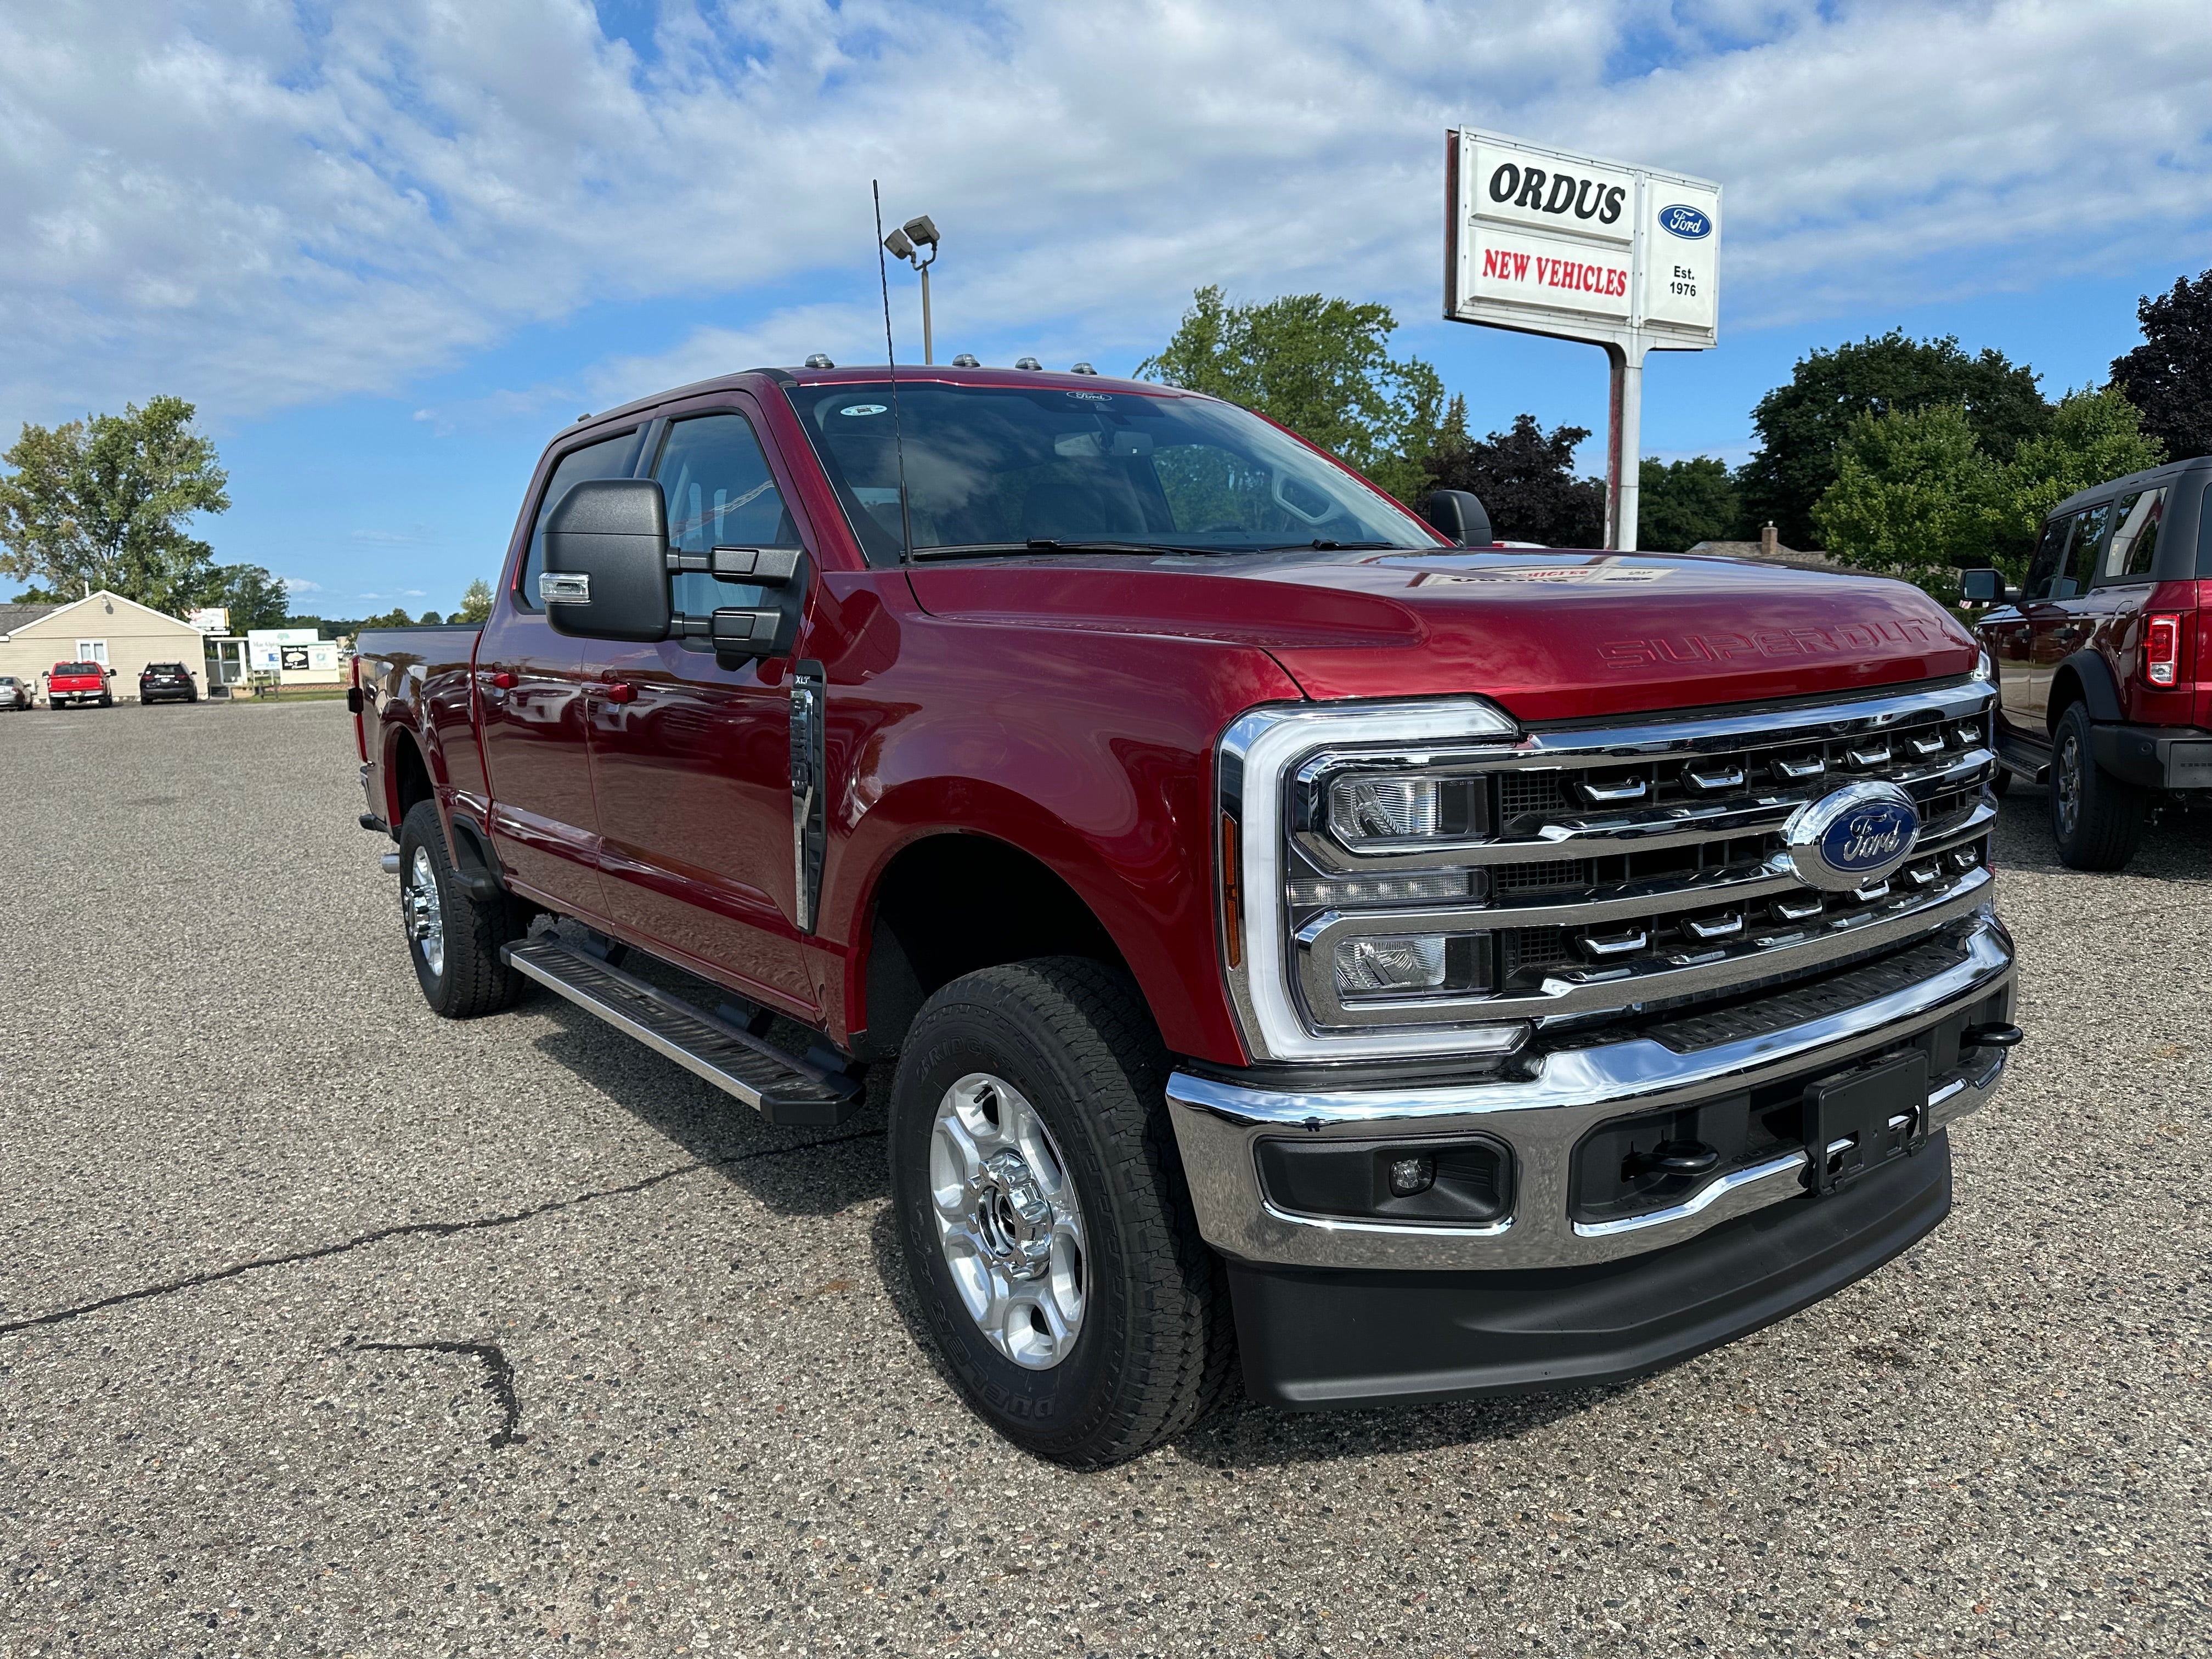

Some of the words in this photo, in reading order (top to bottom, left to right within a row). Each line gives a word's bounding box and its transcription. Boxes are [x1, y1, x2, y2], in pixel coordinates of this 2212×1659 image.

[1488, 163, 1626, 224] ORDUS
[1670, 209, 1702, 234] Ford
[1482, 249, 1531, 282] NEW
[1536, 256, 1627, 297] VEHICLES
[1669, 281, 1696, 297] 1976
[1674, 266, 1695, 280] Est.
[1597, 626, 1839, 669] SUPER
[1834, 616, 1950, 649] DUTY
[795, 675, 811, 685] XLT
[1843, 812, 1901, 861] Ford
